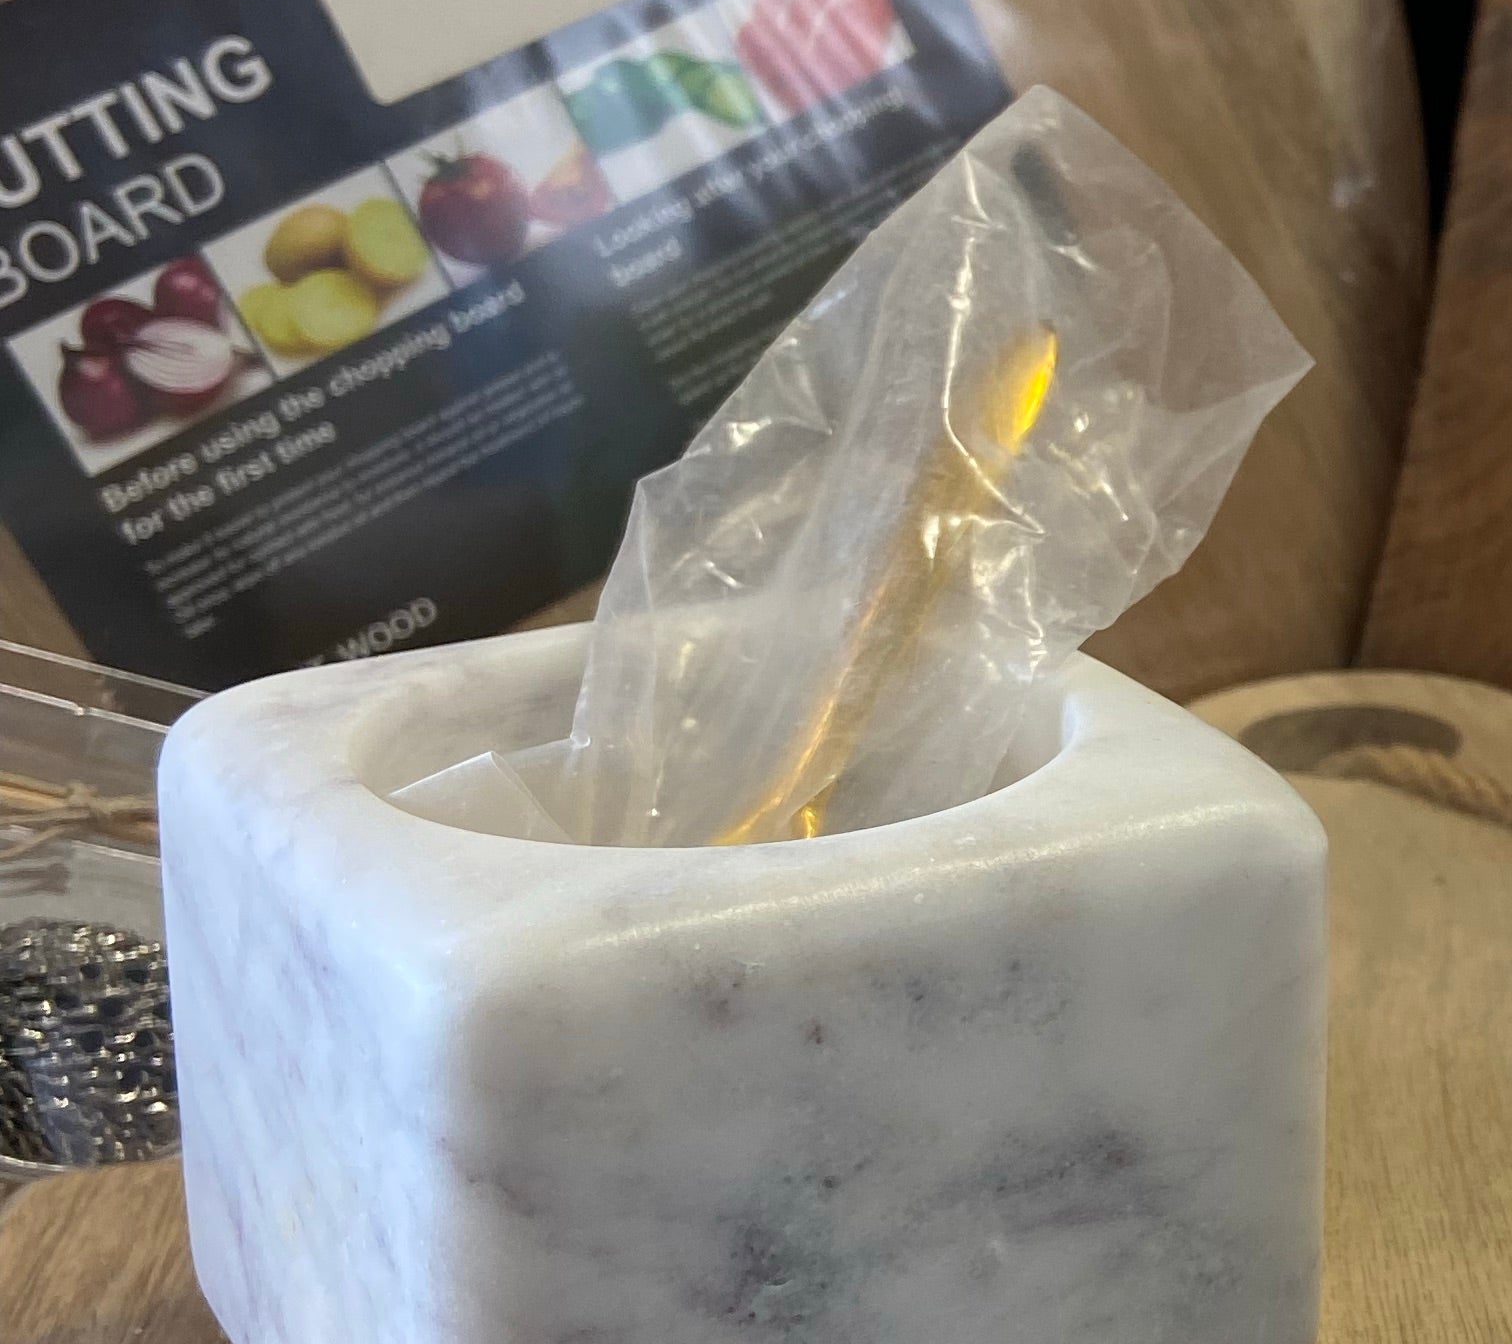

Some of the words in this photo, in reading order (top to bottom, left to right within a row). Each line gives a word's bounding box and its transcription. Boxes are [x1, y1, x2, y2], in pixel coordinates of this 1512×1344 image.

[0, 34, 274, 208] UTTING
[101, 453, 198, 514] Before
[201, 410, 281, 463] using
[278, 386, 325, 421] the
[329, 323, 451, 397] chopping
[449, 279, 526, 334] board
[120, 510, 164, 545] for
[166, 485, 215, 521] the
[216, 450, 277, 495] first
[276, 420, 336, 464] time
